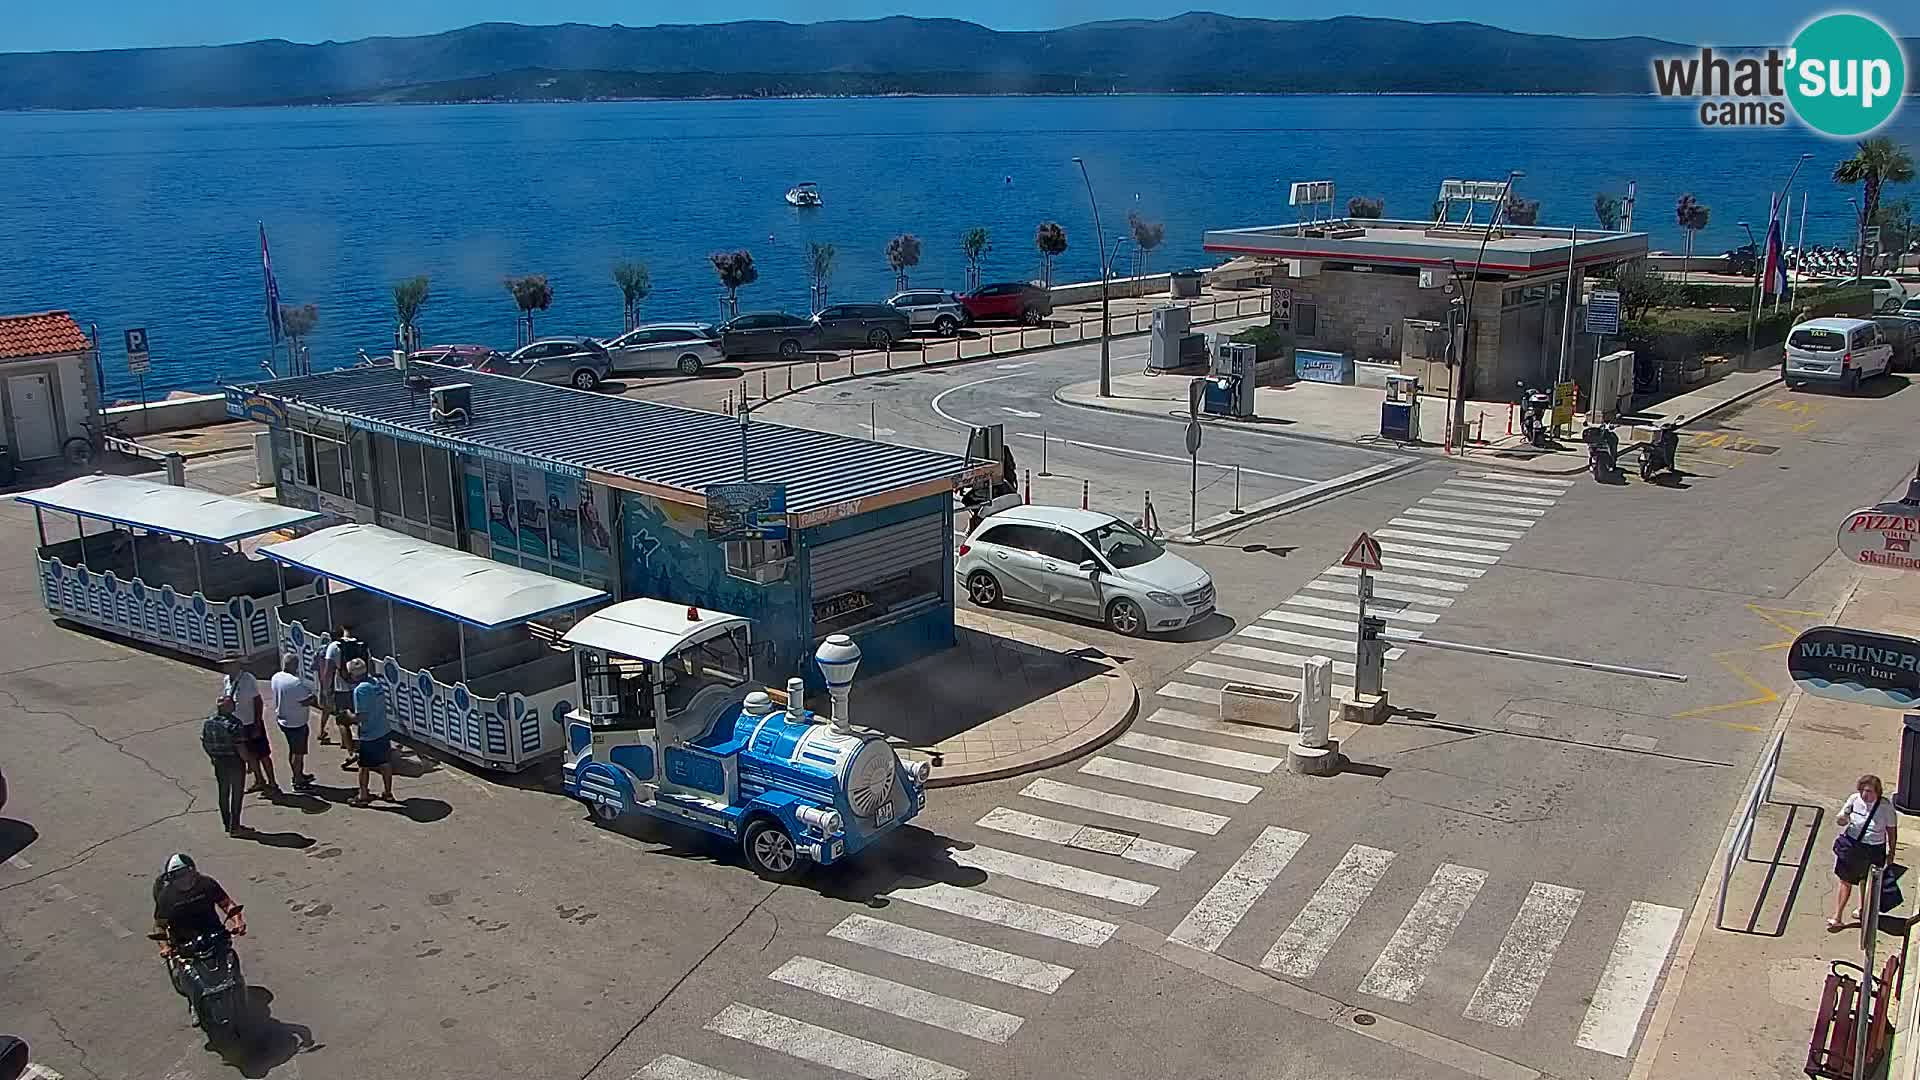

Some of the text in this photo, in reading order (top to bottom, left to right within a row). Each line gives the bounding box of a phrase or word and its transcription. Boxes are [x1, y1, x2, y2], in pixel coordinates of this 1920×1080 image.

[129, 331, 142, 350] P
[526, 458, 554, 473] TICKET
[555, 463, 583, 478] OFFICE
[1848, 515, 1920, 533] PIZZE
[1829, 662, 1897, 680] caffe bar
